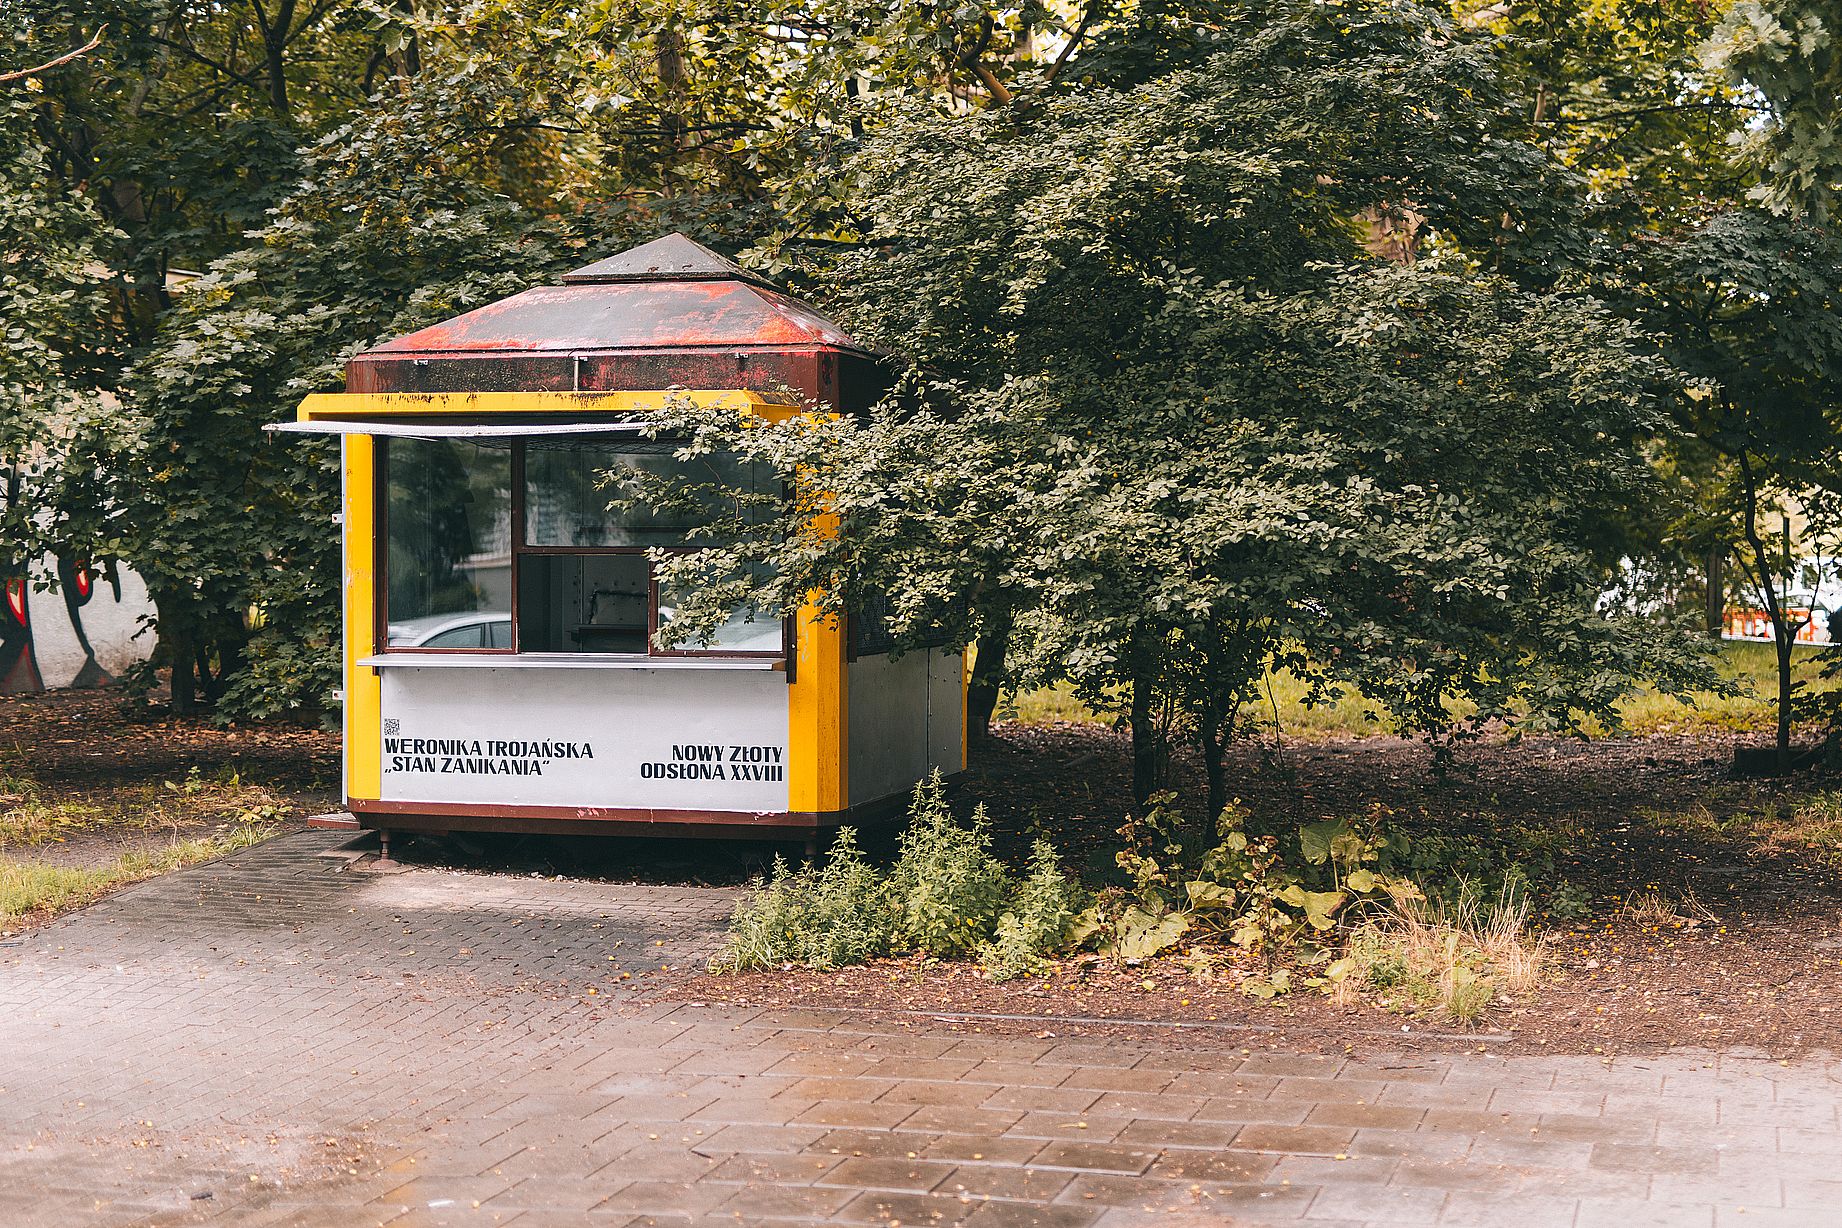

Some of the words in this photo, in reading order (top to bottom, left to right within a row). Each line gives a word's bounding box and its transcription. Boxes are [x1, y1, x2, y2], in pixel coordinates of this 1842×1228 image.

[384, 738, 483, 757] WERONIKA
[486, 738, 594, 759] TROJAŃSKA
[672, 744, 725, 762] NOWY
[729, 745, 783, 763] ZŁOTY
[640, 762, 726, 781] ODSŁONA
[730, 764, 783, 782] XXVIII
